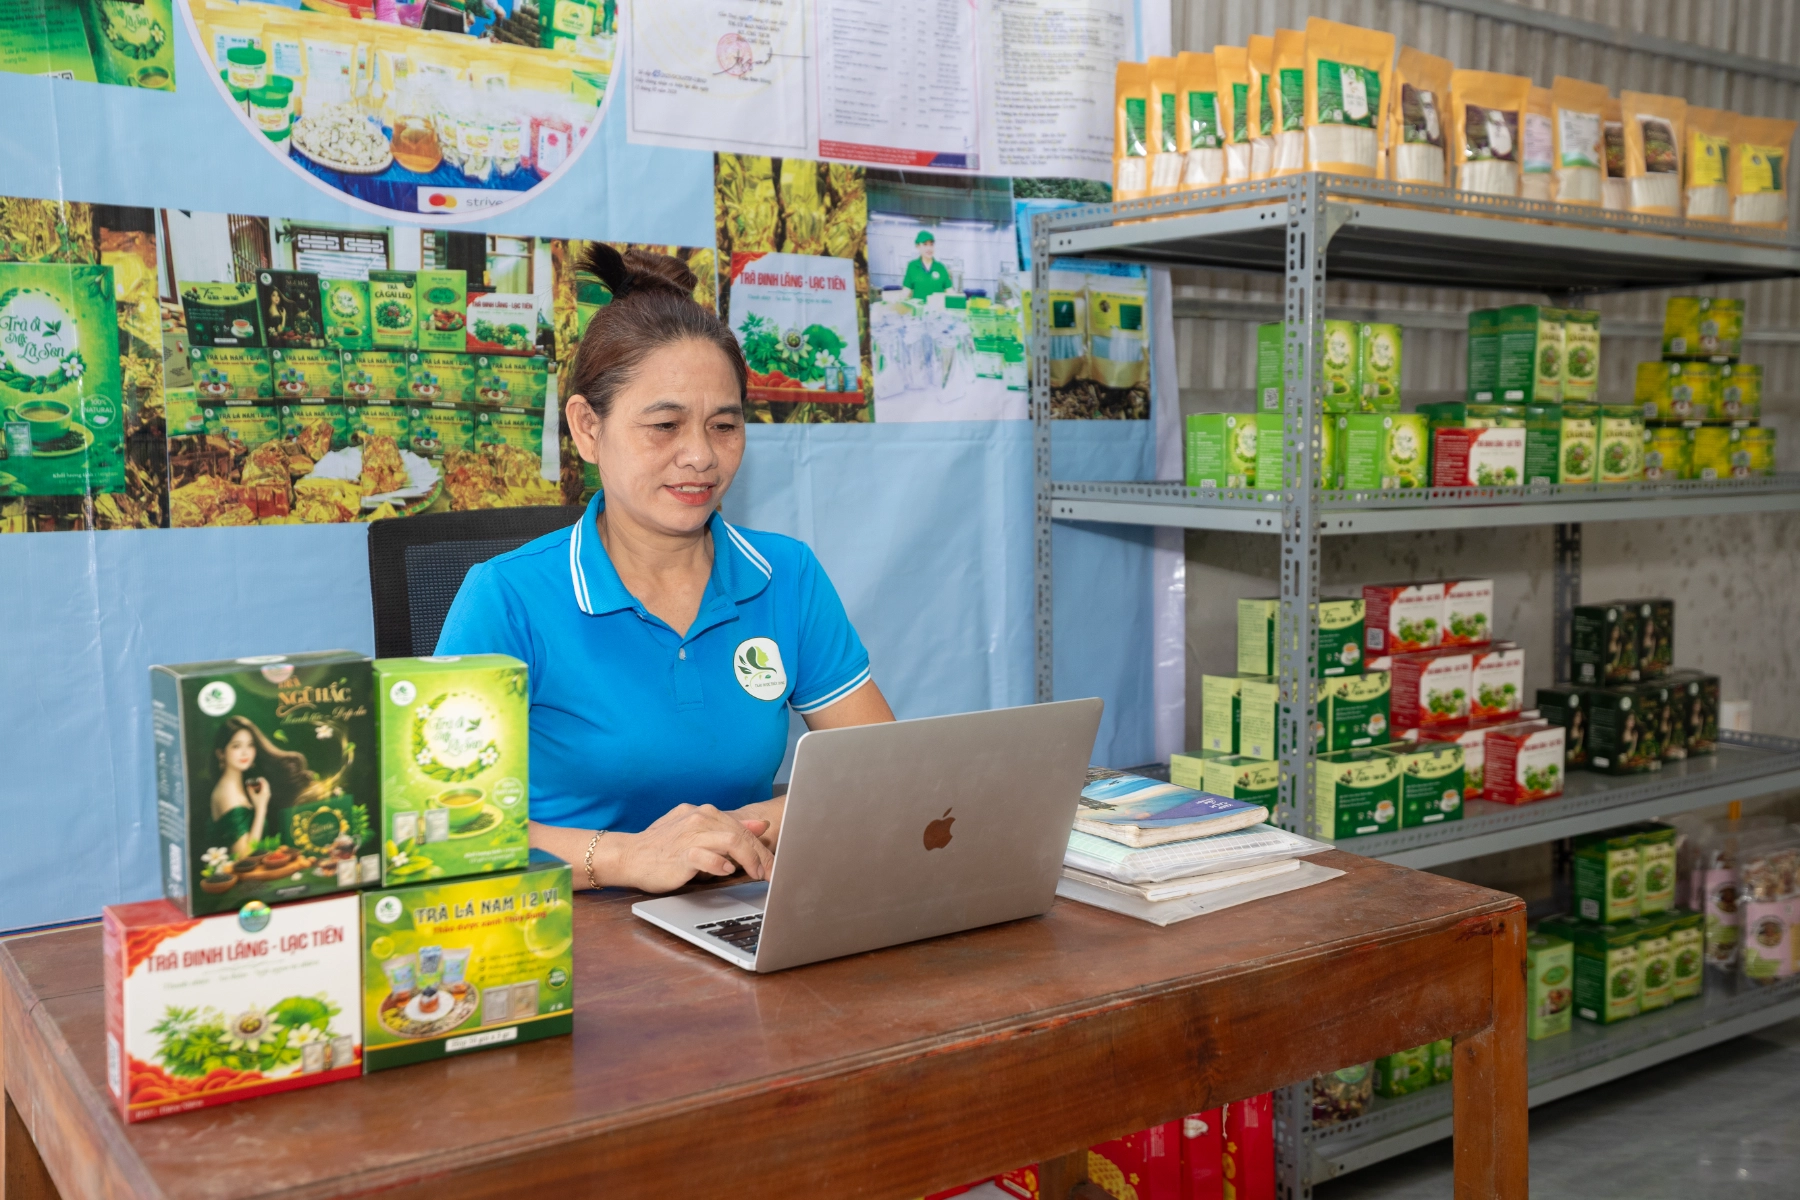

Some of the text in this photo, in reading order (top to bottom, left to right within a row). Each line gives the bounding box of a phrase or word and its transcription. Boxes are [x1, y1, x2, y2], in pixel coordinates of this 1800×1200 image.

[415, 903, 449, 925] TRÀ
[454, 899, 475, 920] LÁ
[480, 895, 515, 915] NAM
[541, 887, 559, 907] VỊ
[147, 950, 179, 973] TRÀ
[183, 946, 223, 969] ĐINH
[227, 939, 269, 962] LĂNG
[281, 934, 308, 956] LẠC
[311, 925, 345, 948] TIÊN
